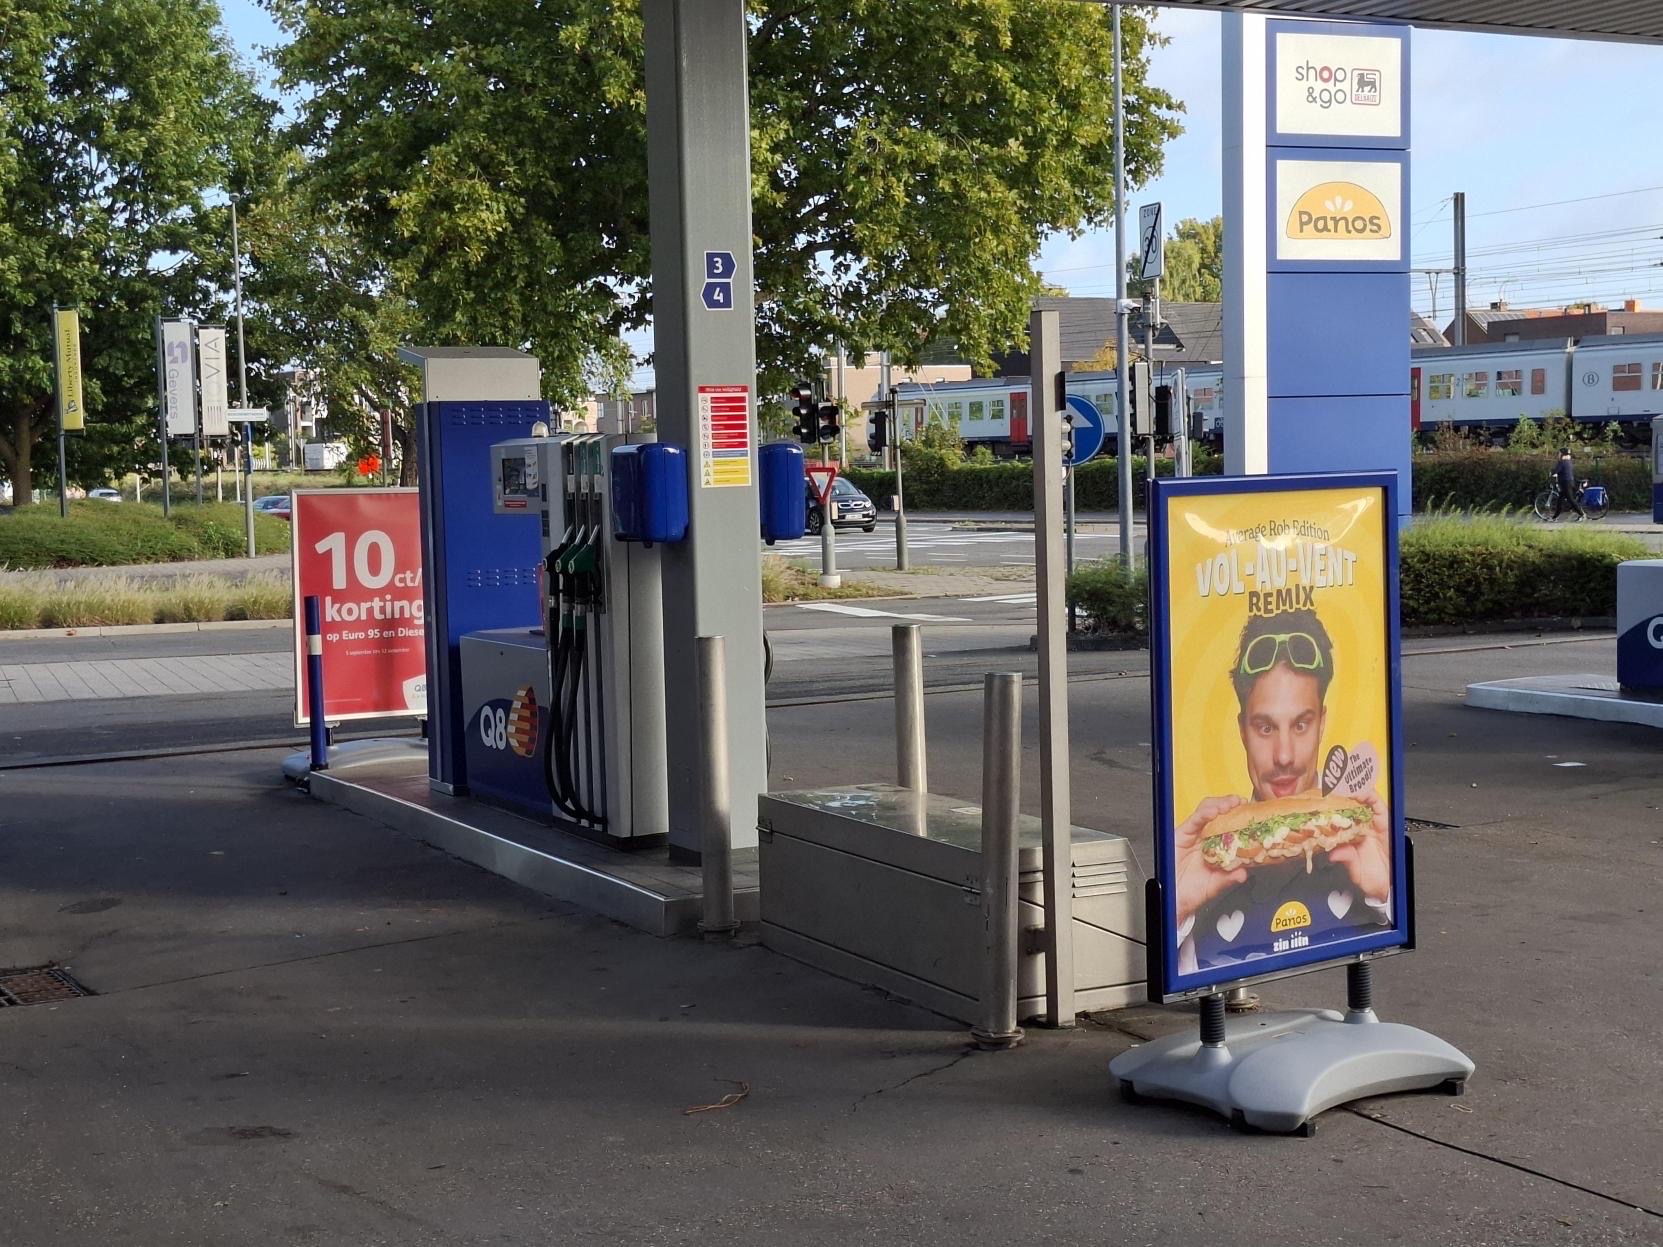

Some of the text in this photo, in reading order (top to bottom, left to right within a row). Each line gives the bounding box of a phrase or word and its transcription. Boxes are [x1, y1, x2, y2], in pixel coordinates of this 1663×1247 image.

[1295, 59, 1347, 87] shop
[1306, 86, 1347, 109] &go
[1298, 210, 1382, 235] Panos
[713, 257, 723, 274] 3
[713, 287, 724, 304] 4
[168, 368, 179, 419] Gevers
[1224, 520, 1330, 548] Average Rob Edition
[314, 529, 396, 590] 10
[1196, 543, 1358, 598] VOL-AU-VENT
[325, 594, 424, 625] korting
[1248, 584, 1315, 615] REMIX
[326, 632, 340, 643] op
[342, 630, 366, 641] Euro
[367, 628, 380, 639] 95
[382, 629, 395, 638] en
[480, 705, 507, 750] Q8
[1344, 756, 1372, 784] Ultimate
[1349, 753, 1360, 765] The
[1348, 765, 1374, 793] Broodje
[1275, 914, 1307, 929] Panos
